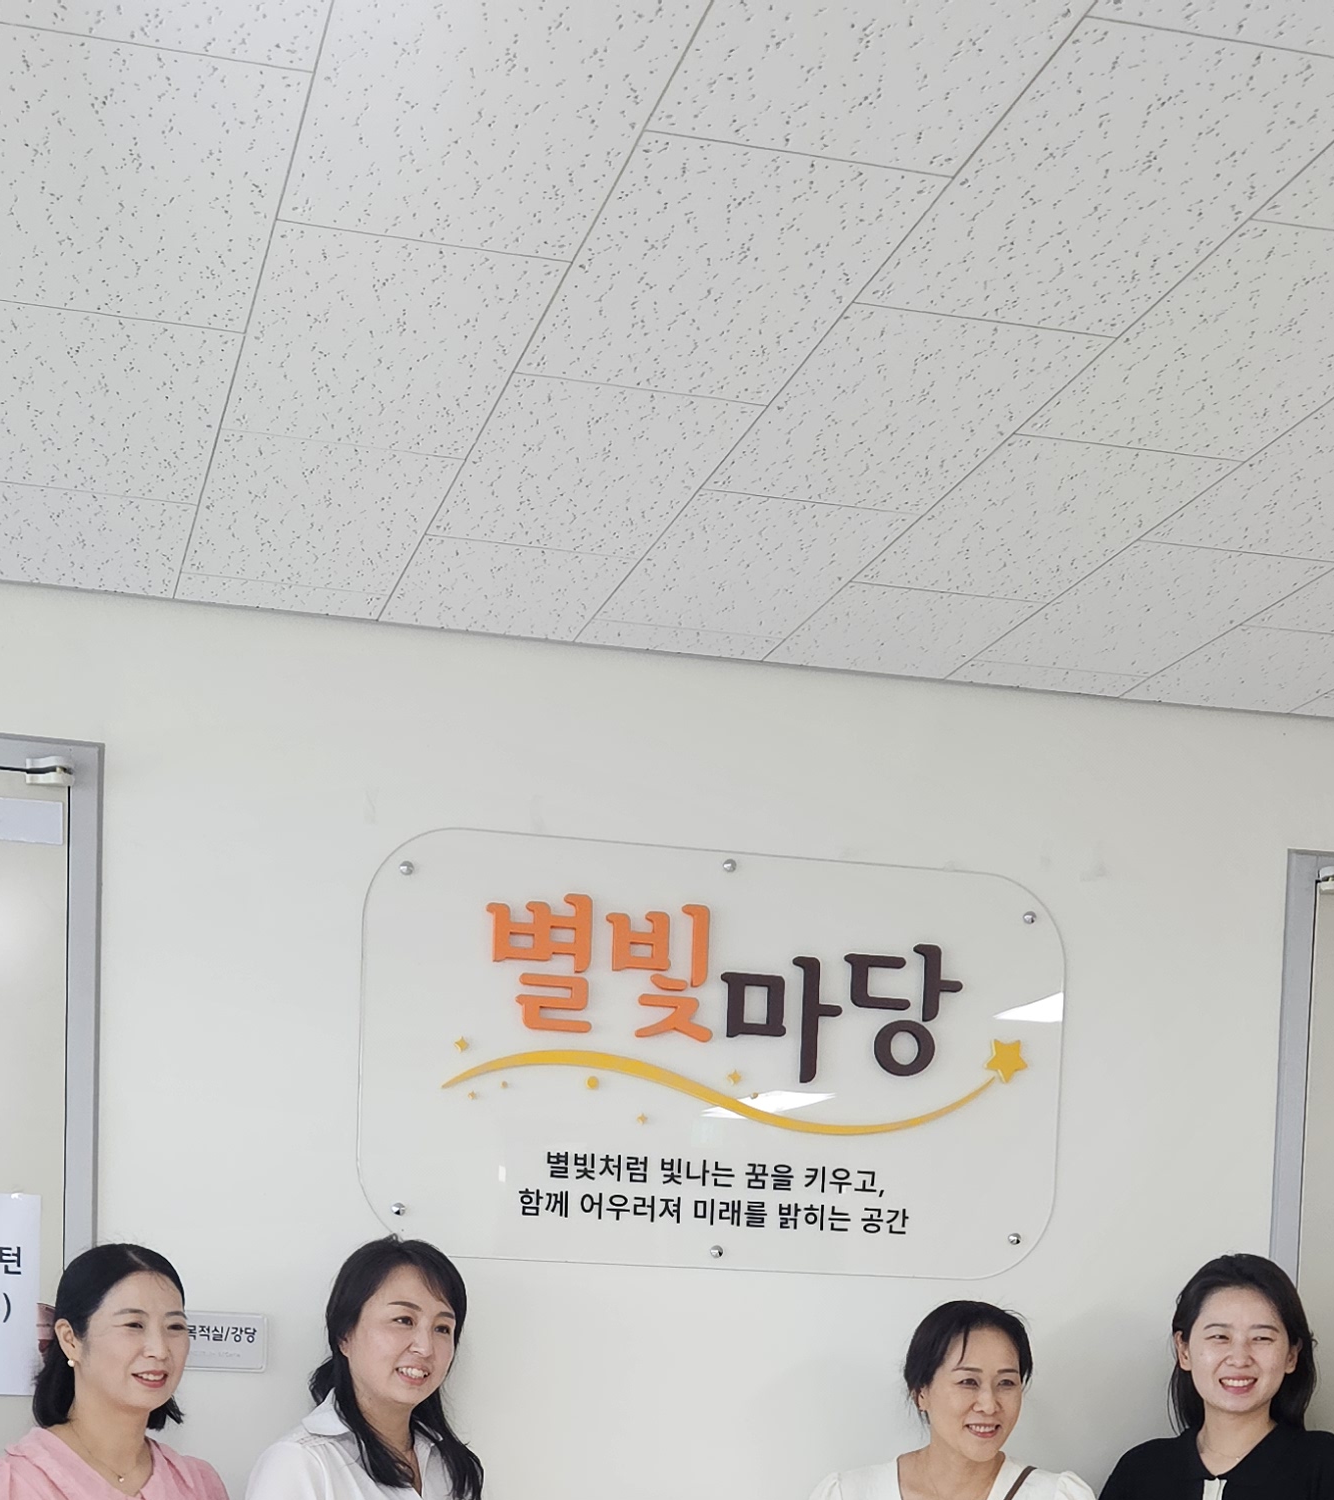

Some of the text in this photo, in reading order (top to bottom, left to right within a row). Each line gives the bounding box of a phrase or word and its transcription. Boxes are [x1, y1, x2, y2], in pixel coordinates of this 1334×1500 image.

[487, 894, 963, 1083] 별빛마당
[546, 1151, 886, 1198] 별빛처럼 빛나는 꿈을 키우고,
[518, 1188, 910, 1236] 함께 어우러져 미래를 밝히는 공간
